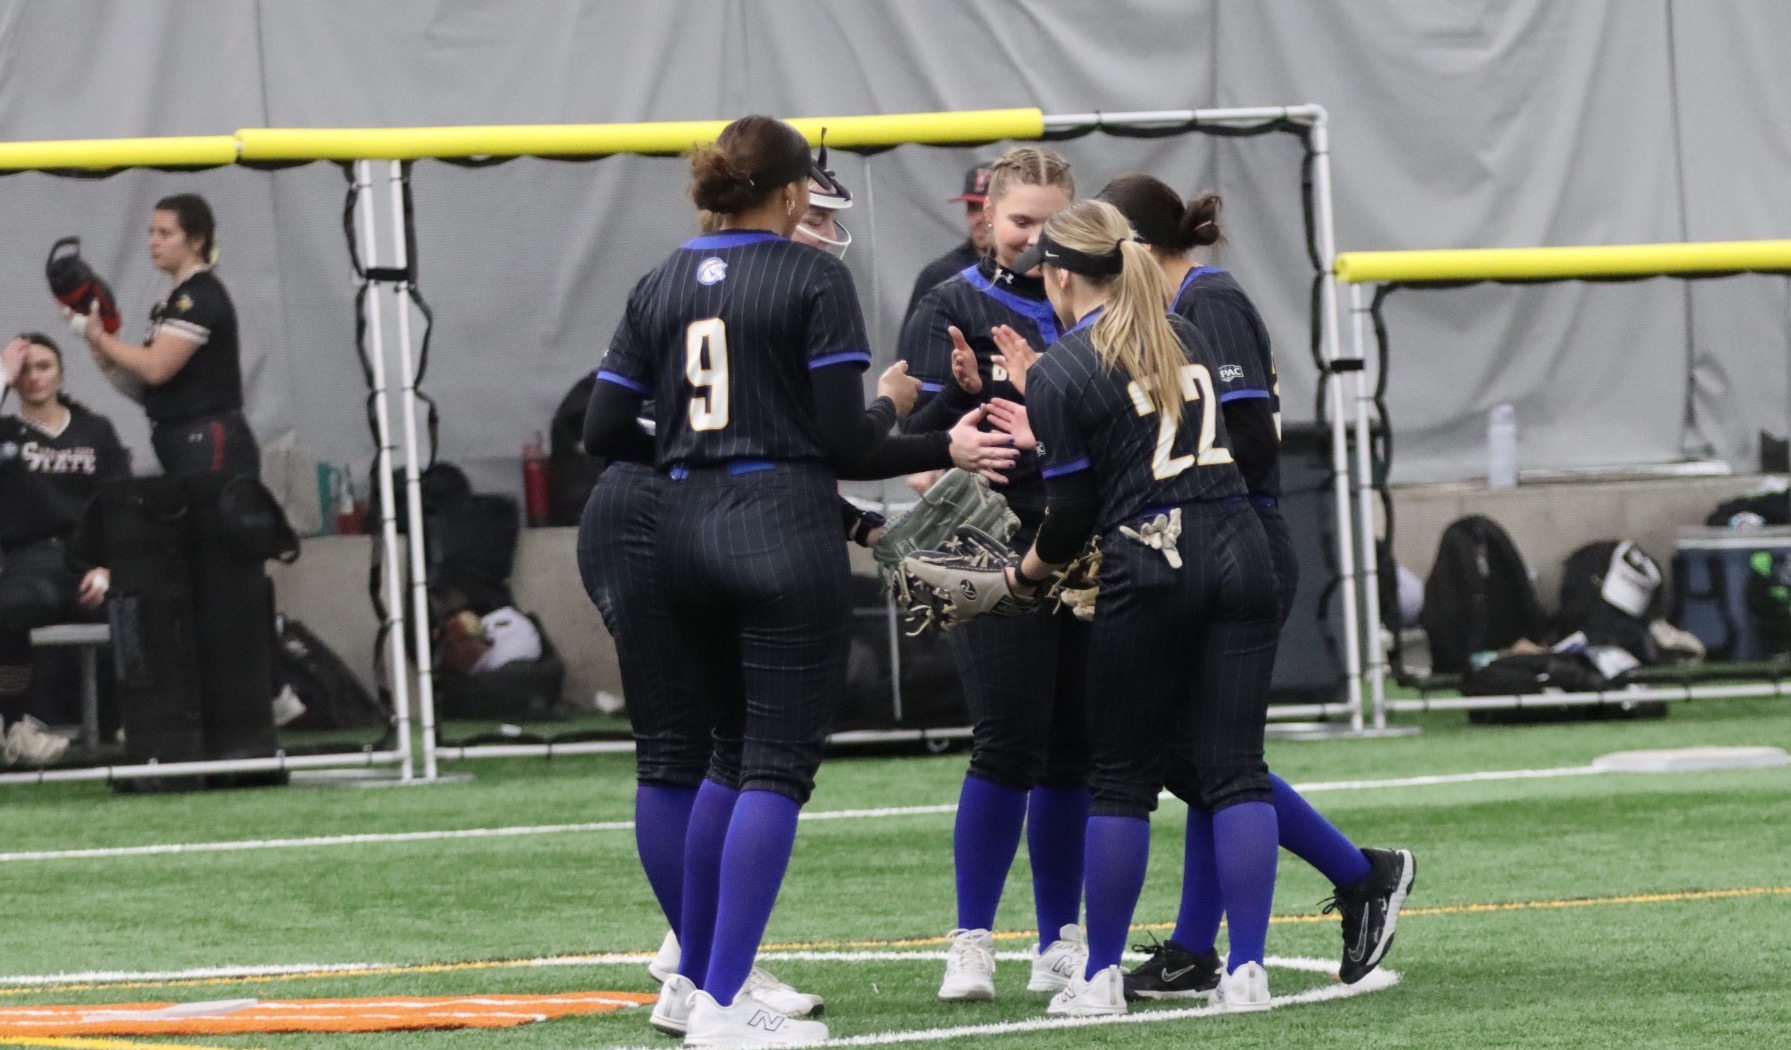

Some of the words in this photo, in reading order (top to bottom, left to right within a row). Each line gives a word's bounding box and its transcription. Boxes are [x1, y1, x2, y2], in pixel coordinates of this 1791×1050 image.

[686, 318, 729, 431] 9
[1220, 367, 1242, 379] PAC
[1128, 364, 1235, 480] 22
[747, 1009, 785, 1031] N
